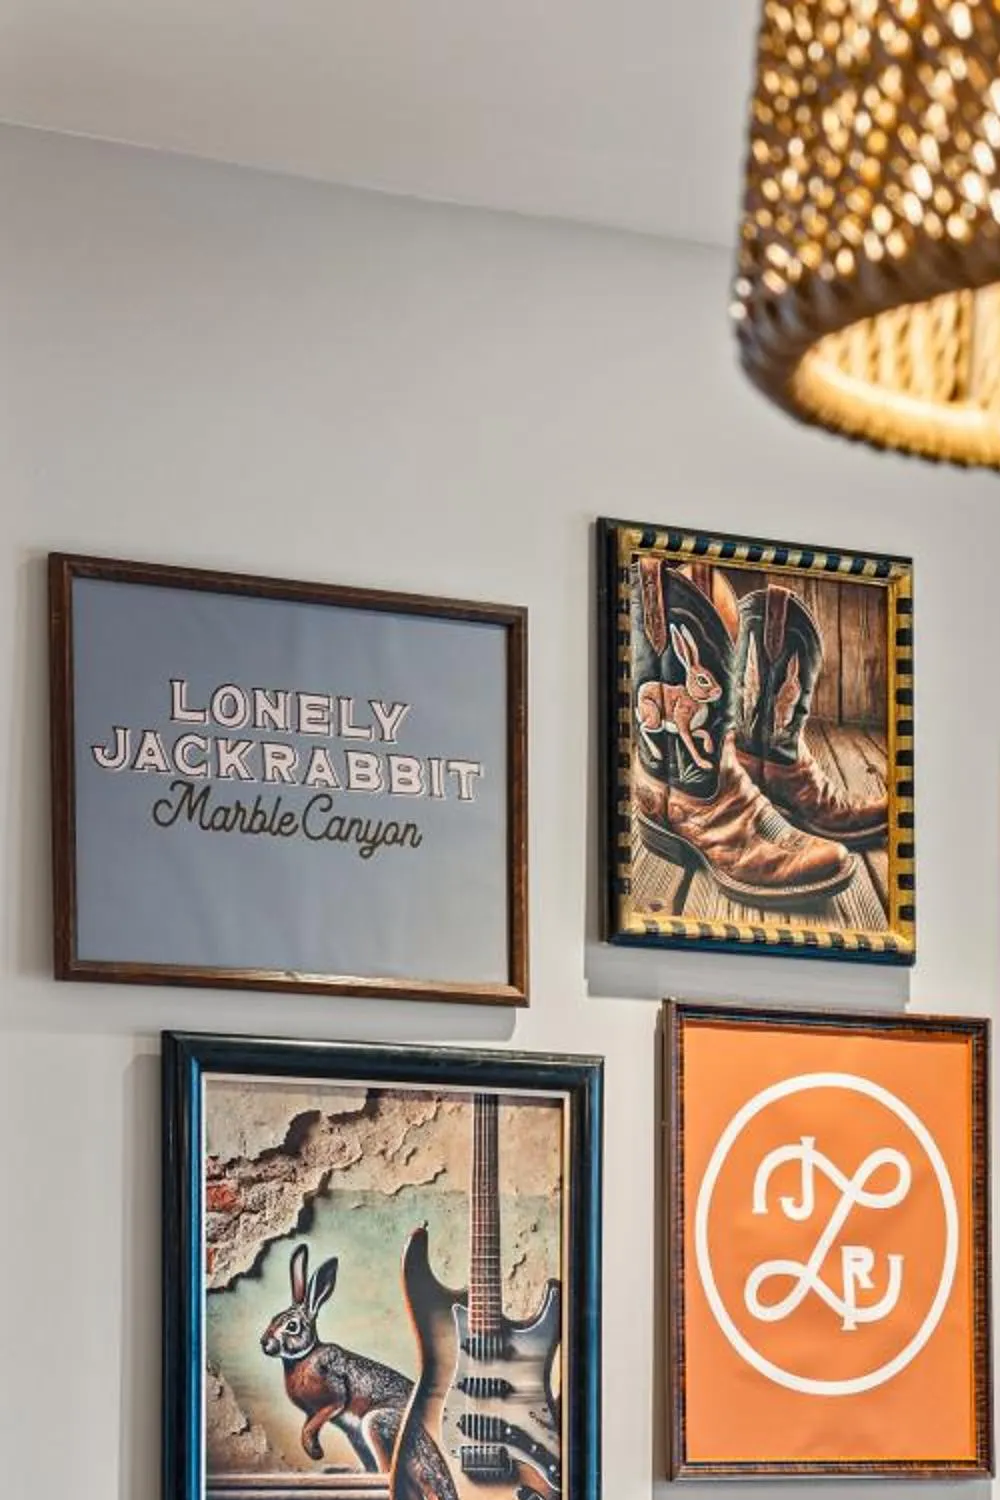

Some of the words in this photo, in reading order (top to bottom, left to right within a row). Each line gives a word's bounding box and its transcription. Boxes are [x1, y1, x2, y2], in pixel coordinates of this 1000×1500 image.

[169, 679, 411, 743] LONELY
[92, 726, 485, 801] JACKRABBIT
[152, 779, 299, 836] Marble
[302, 793, 422, 859] Canyon
